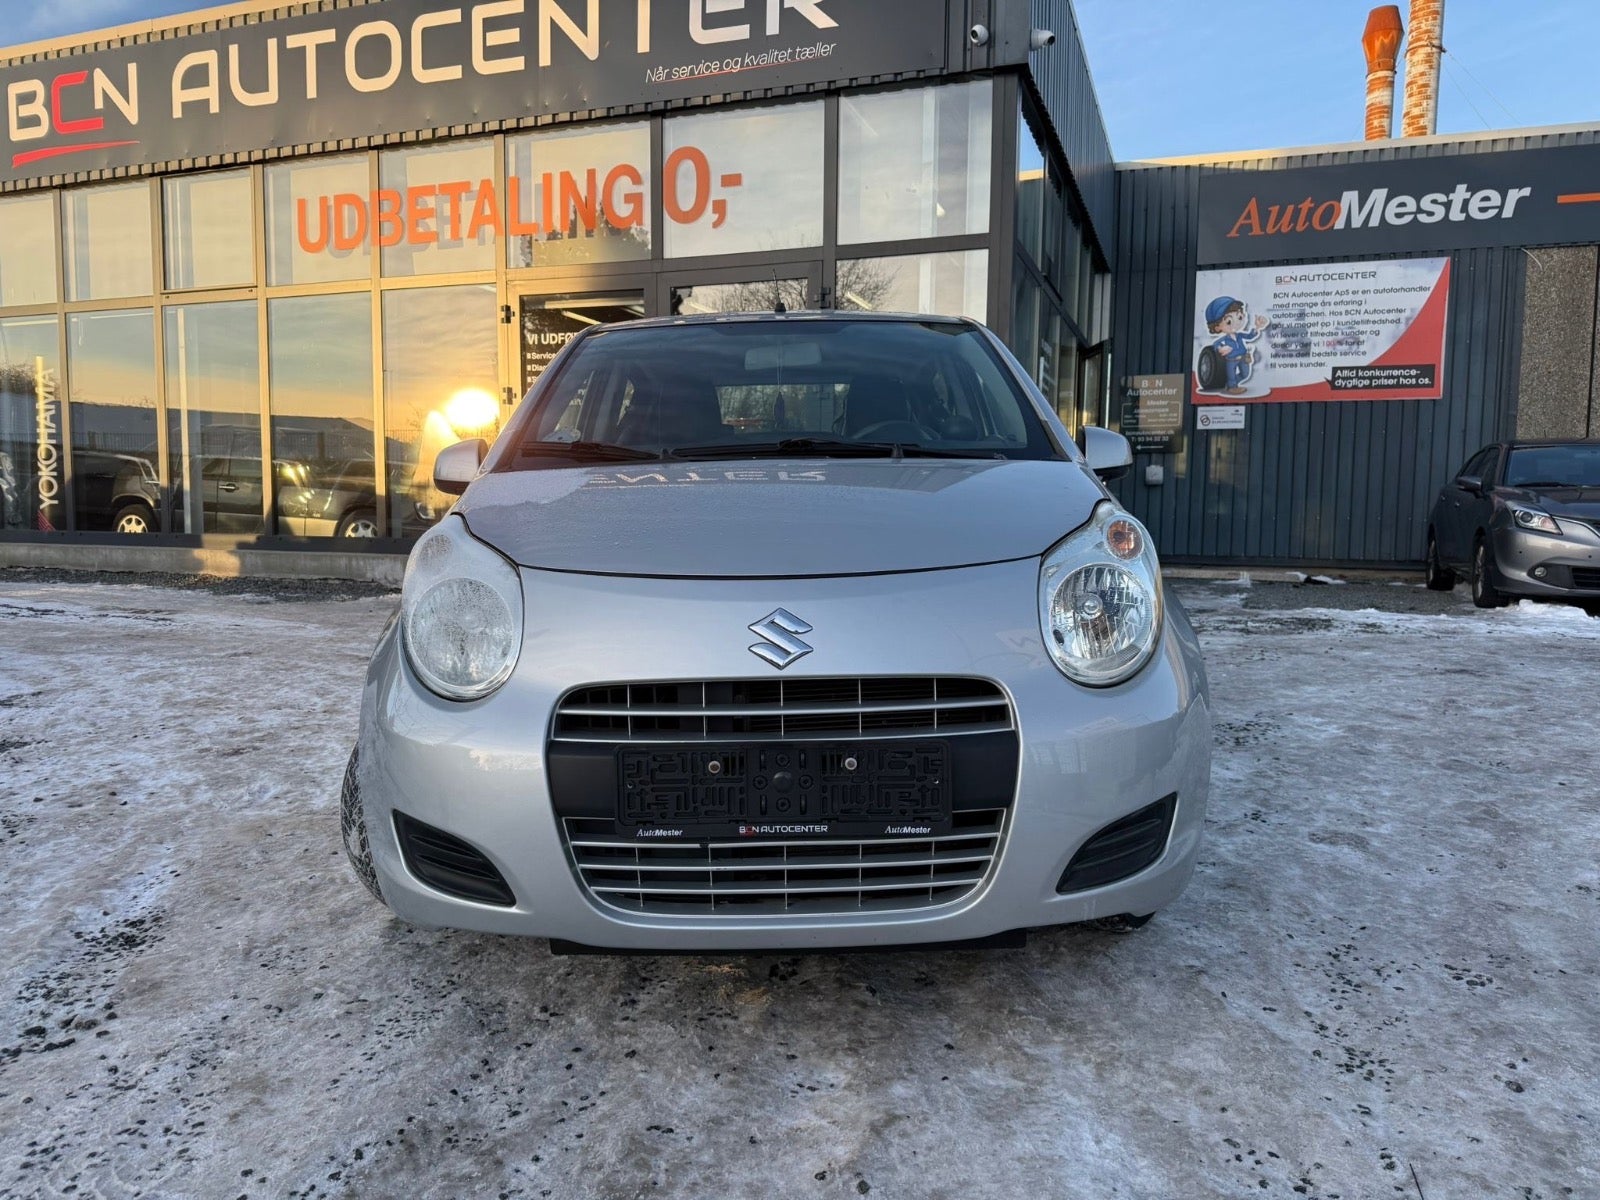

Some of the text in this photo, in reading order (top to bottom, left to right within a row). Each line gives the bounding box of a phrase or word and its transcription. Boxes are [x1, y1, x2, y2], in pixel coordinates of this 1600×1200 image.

[645, 41, 836, 83] Når service og kvalitet tæller
[7, 62, 139, 142] BCN
[297, 164, 644, 254] UDBETALING
[1226, 183, 1532, 238] AutoMester
[1275, 271, 1377, 284] BCN AUTOCENTER
[1291, 290, 1333, 298] Autocenter
[1334, 289, 1349, 297] ApS
[1373, 286, 1431, 294] autoforhandler
[1272, 311, 1326, 319] autobranchen.
[1271, 322, 1285, 330] går
[1294, 321, 1319, 330] meget
[527, 333, 539, 345] VI
[1335, 368, 1421, 378] Altid konkurrence-
[1334, 377, 1432, 388] dygtige priser hos os.
[1126, 388, 1177, 397] Autocenter
[35, 368, 58, 510] YOKOHAMA
[636, 828, 683, 837] AutoMester
[739, 825, 828, 834] BCN AUTOCENTER
[884, 825, 932, 834] AutoMester
